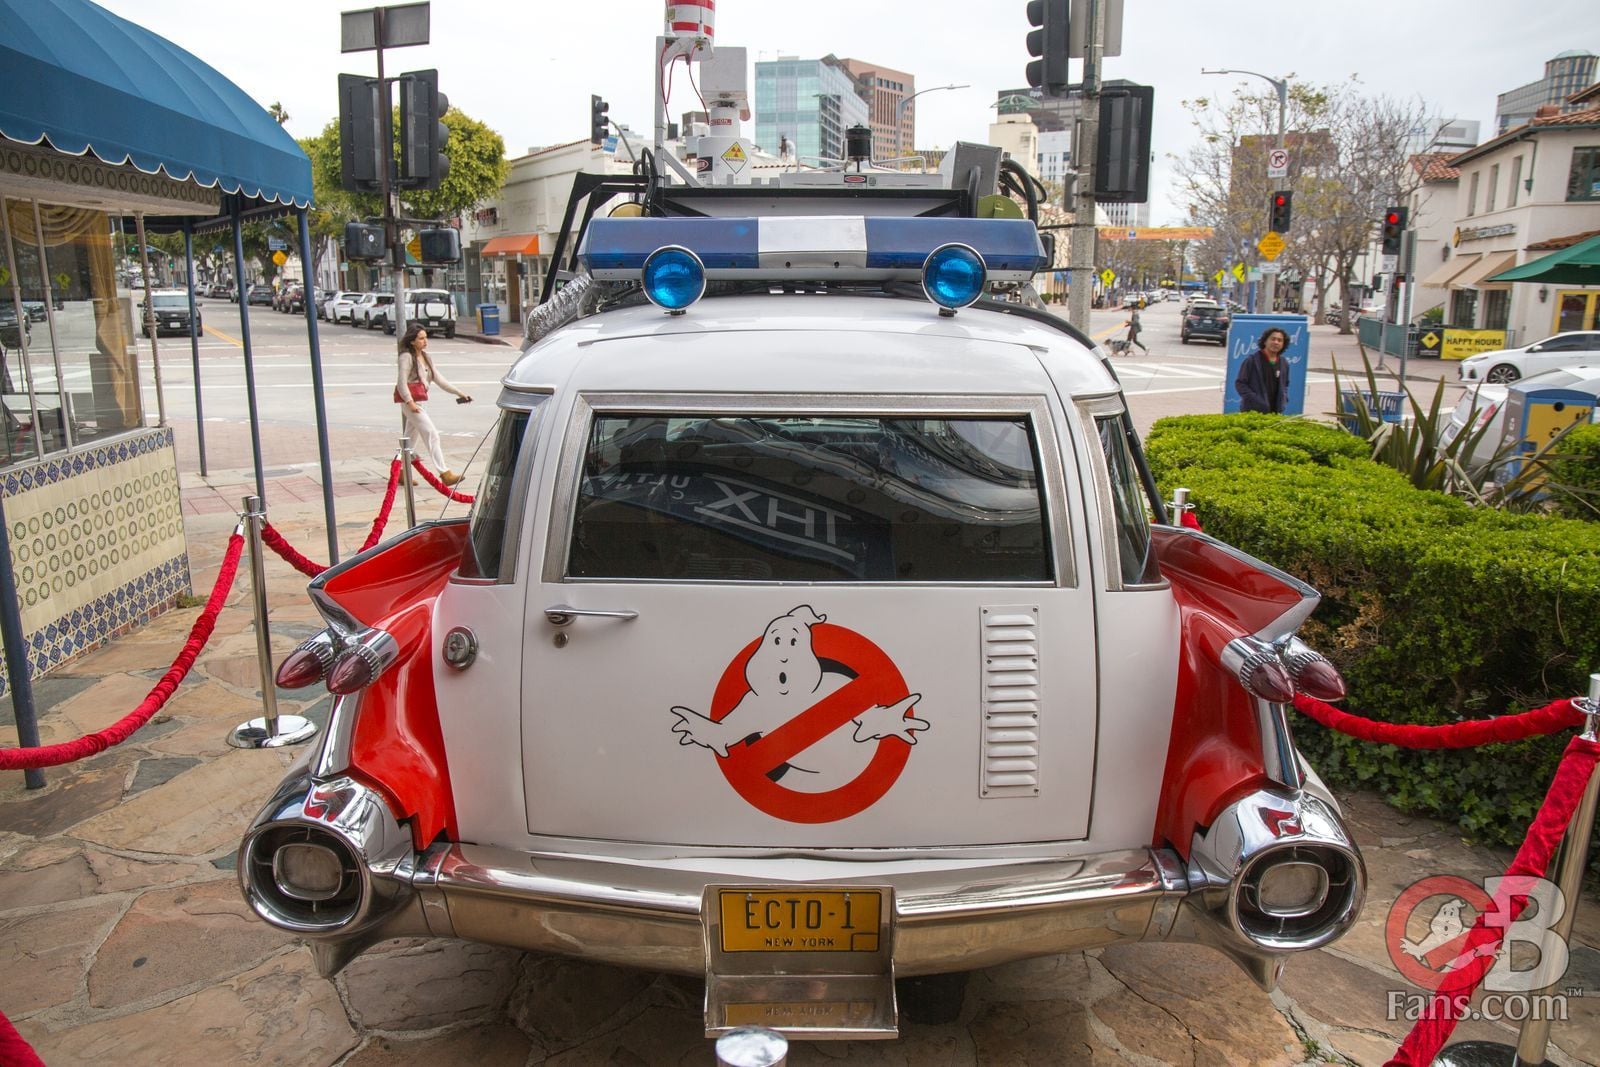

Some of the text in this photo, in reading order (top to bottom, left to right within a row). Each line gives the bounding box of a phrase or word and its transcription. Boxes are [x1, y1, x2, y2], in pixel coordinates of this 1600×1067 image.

[1446, 337, 1502, 346] HAPPY HOURS
[744, 899, 855, 929] ECTO-1
[765, 937, 835, 947] NEW YORK
